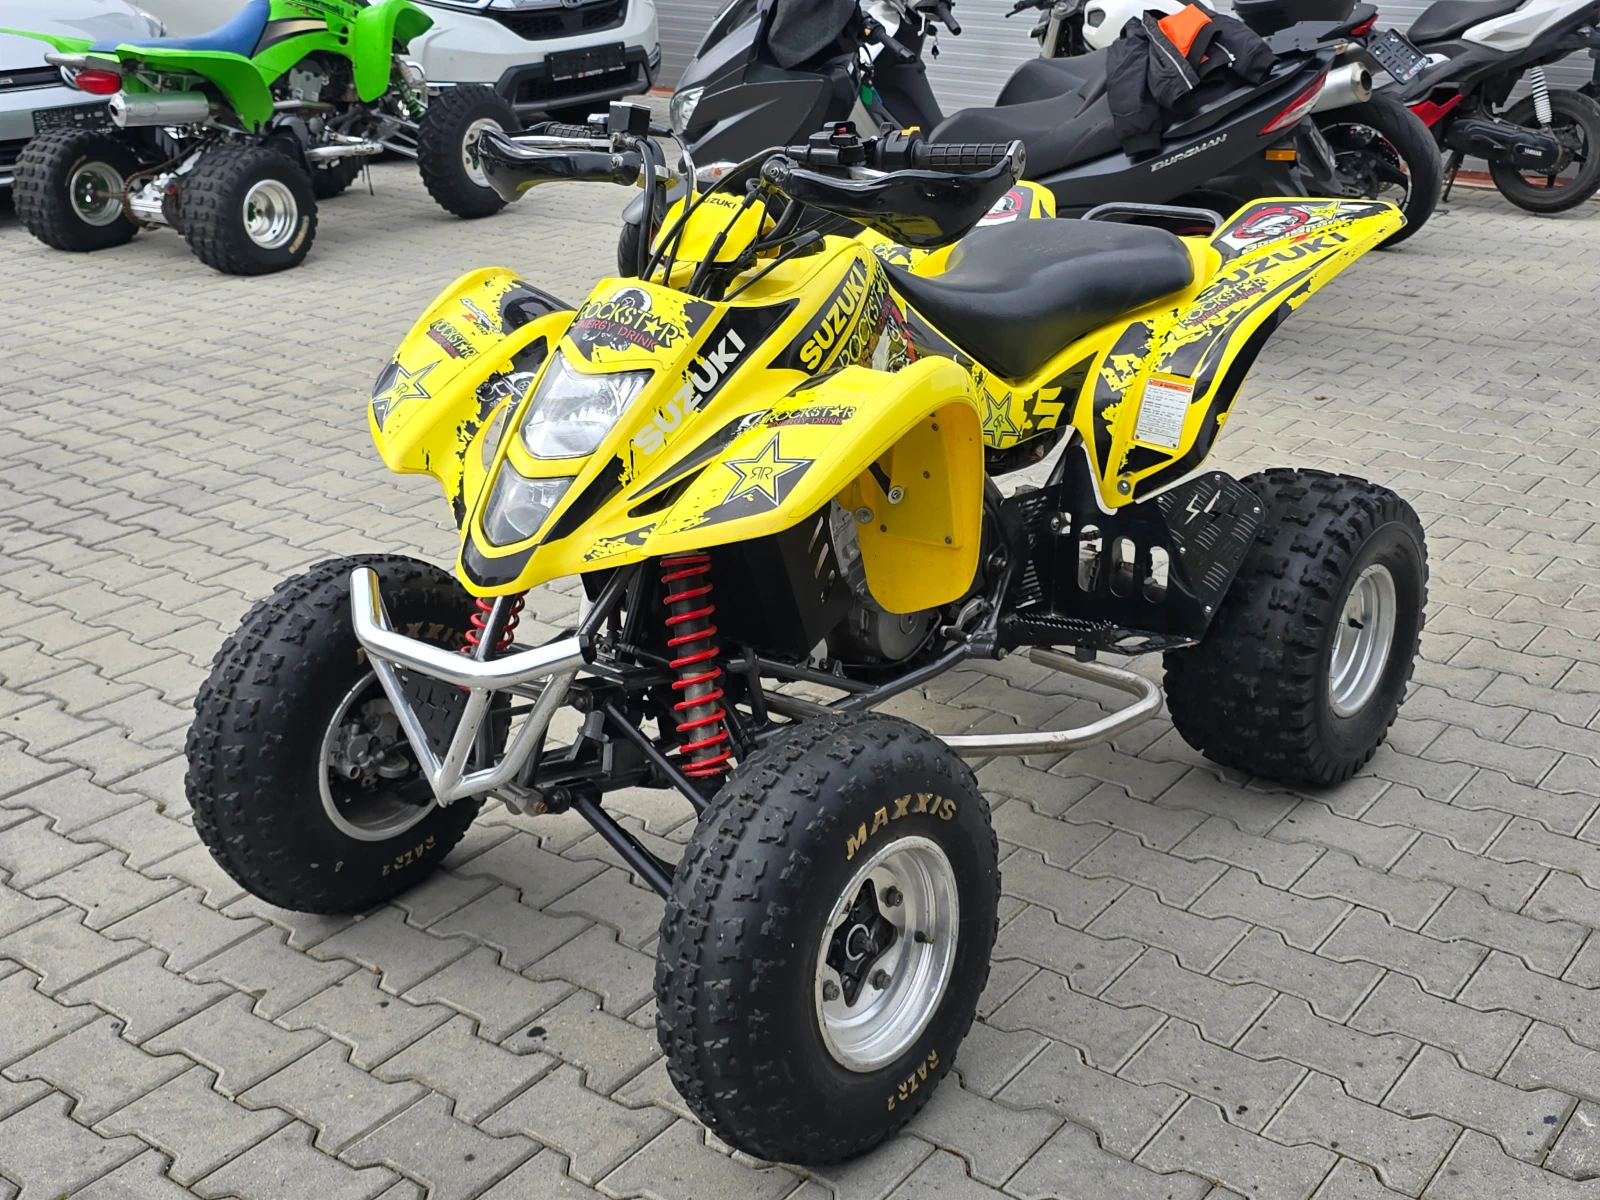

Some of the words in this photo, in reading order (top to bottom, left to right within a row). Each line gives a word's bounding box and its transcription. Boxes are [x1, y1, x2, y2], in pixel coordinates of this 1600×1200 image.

[1150, 133, 1228, 172] BURGMAN
[703, 197, 737, 210] UZUKI
[573, 319, 616, 332] ENERGY
[617, 325, 658, 352] DRINK
[575, 300, 681, 348] ROCKSTAR
[800, 264, 866, 371] SUZUKI
[430, 318, 479, 359] ROCKSTAR
[633, 328, 747, 456] SUZUKI
[764, 404, 857, 424] ROCKSTAR
[845, 792, 958, 861] MAXXIS
